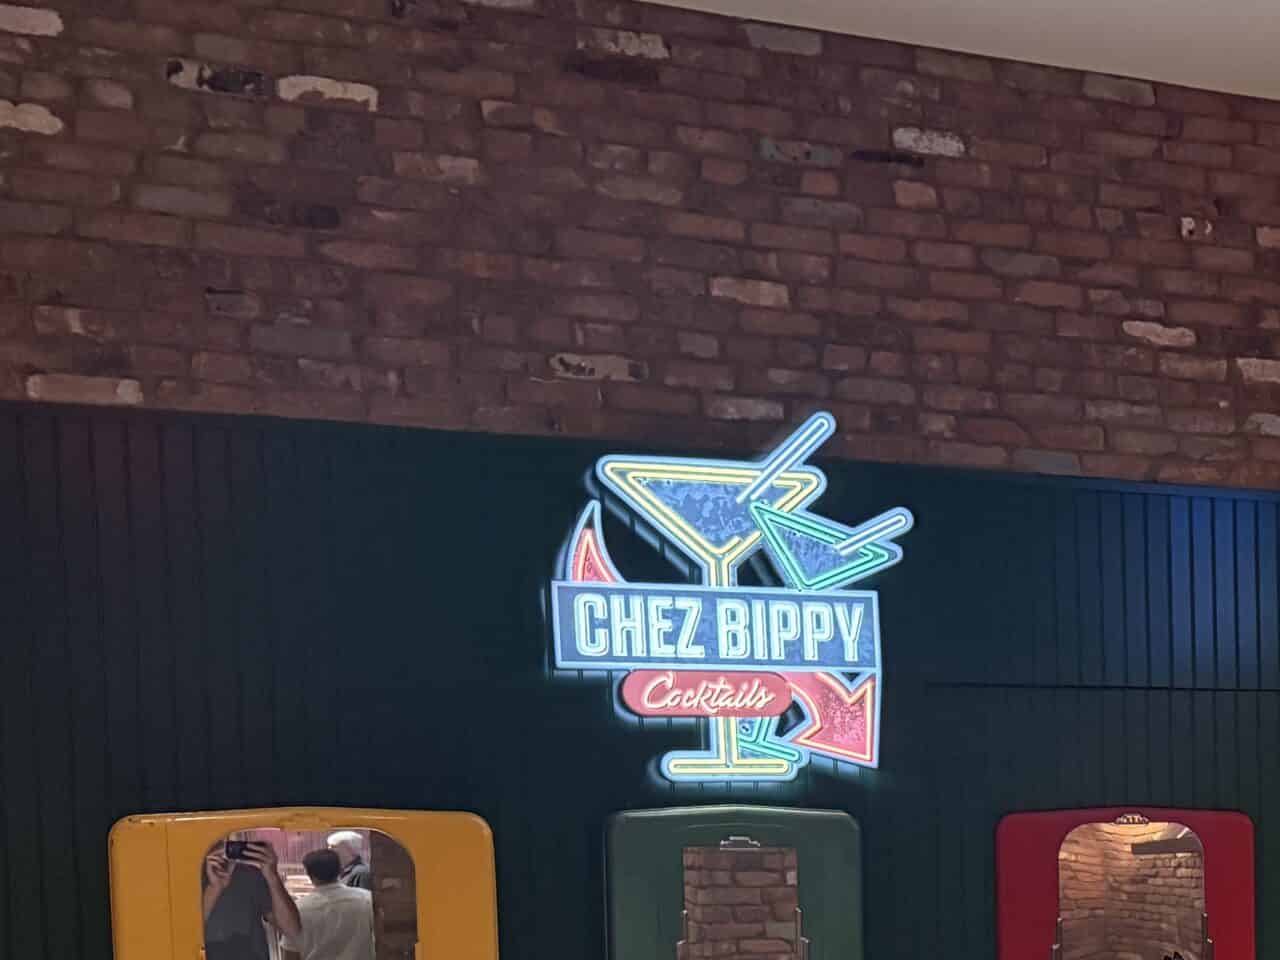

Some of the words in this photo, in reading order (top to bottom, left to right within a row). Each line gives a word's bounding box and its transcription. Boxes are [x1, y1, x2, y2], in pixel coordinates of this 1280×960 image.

[573, 592, 706, 658] CHEZ
[716, 597, 865, 662] BIPPY
[642, 671, 776, 716] Cocktails
